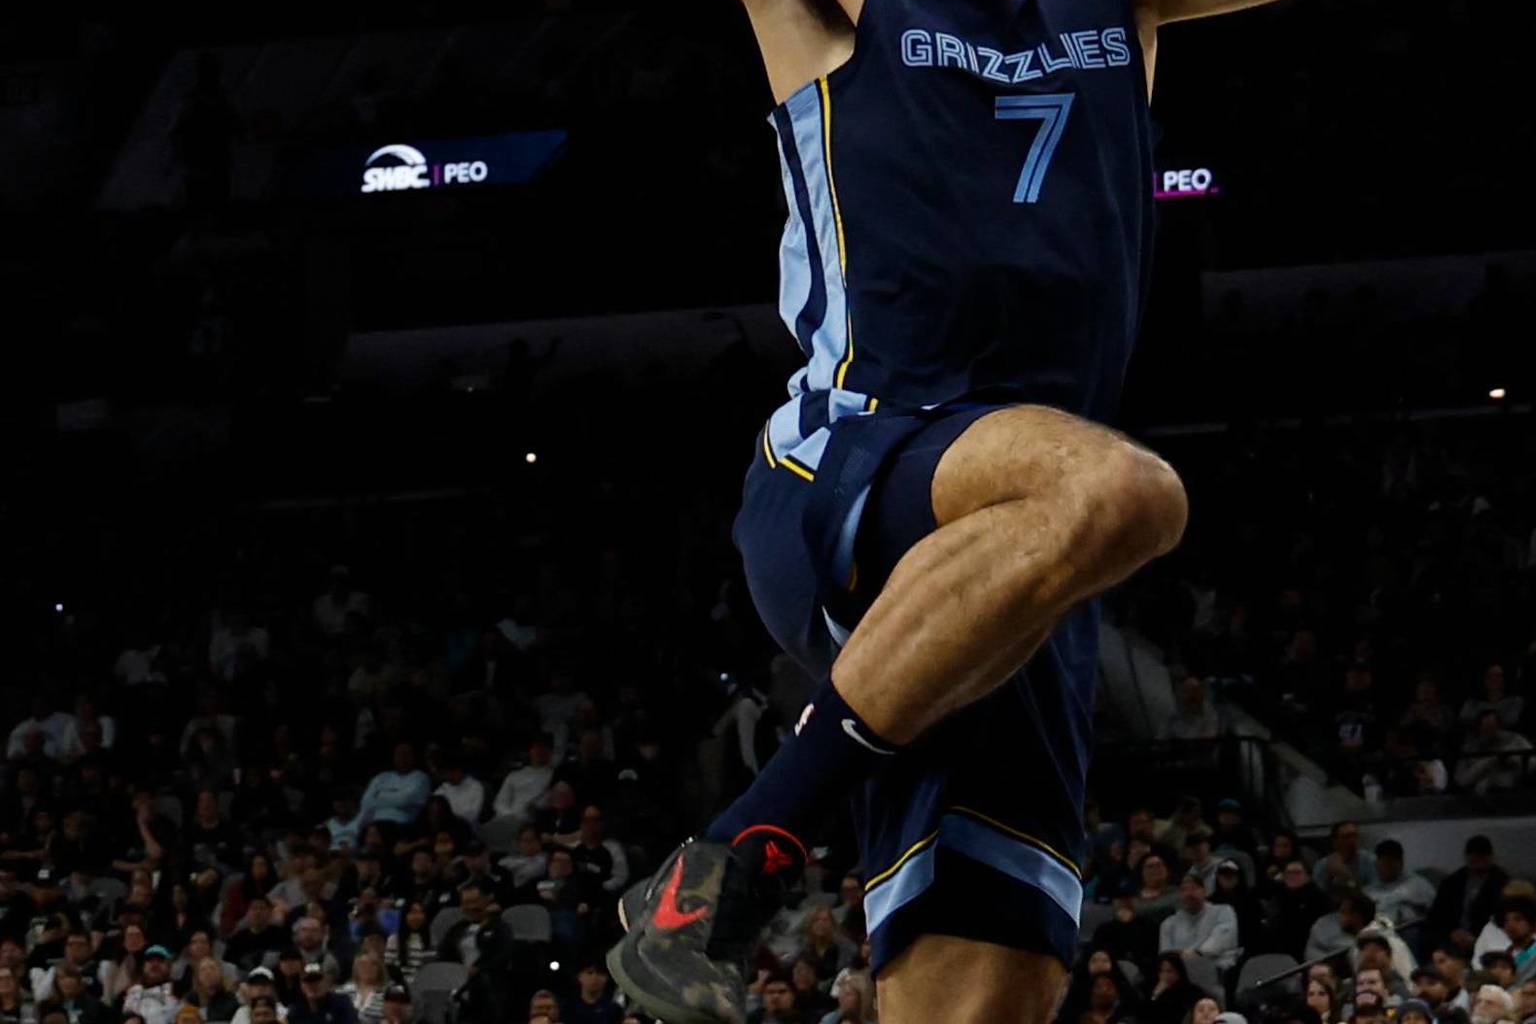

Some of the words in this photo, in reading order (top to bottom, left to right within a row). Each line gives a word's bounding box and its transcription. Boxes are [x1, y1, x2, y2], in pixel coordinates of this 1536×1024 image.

[901, 28, 1131, 84] GRIZZLIES
[994, 92, 1075, 203] 7
[361, 164, 431, 193] SWBC
[444, 161, 488, 183] PEO
[1163, 168, 1212, 192] PEO
